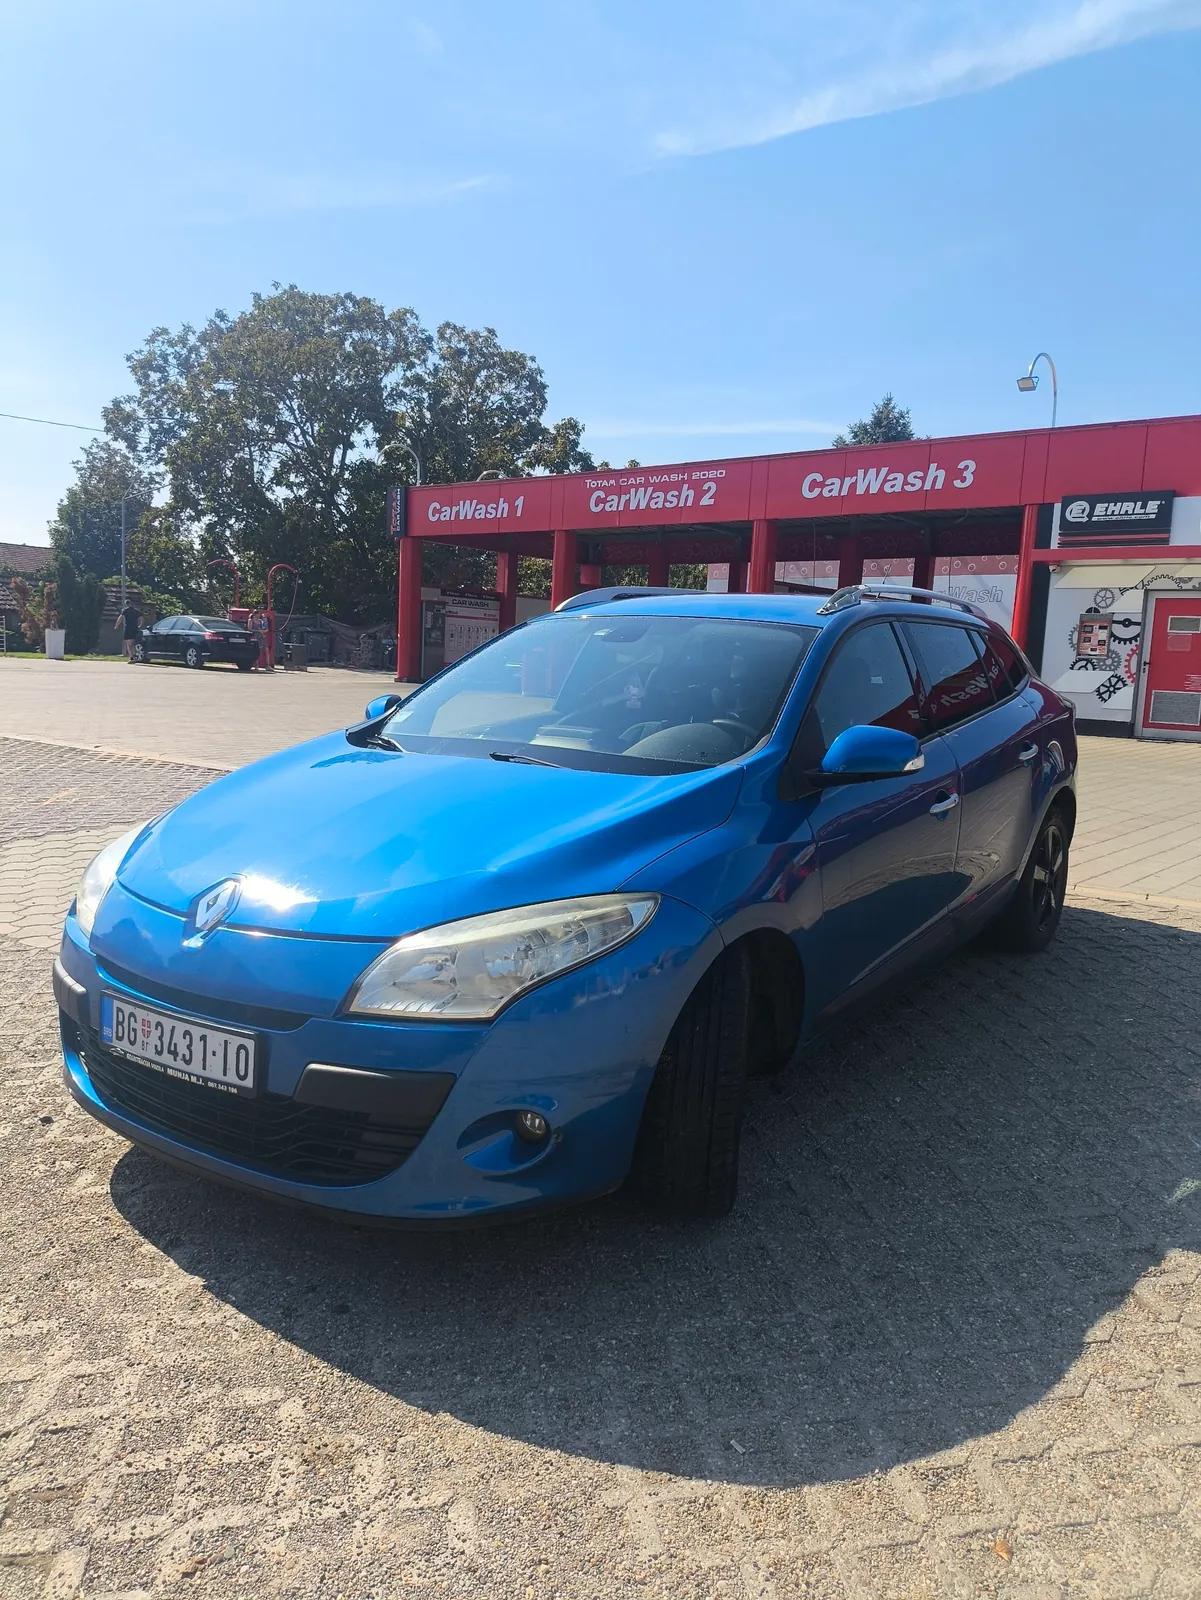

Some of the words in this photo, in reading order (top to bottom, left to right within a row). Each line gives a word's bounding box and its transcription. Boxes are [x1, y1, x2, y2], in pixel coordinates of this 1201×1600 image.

[619, 476, 645, 486] CAR
[648, 473, 688, 484] WASH
[691, 469, 726, 480] 2020
[801, 463, 946, 499] CarWash
[953, 459, 977, 489] 3
[589, 483, 695, 513] CarWash
[700, 481, 717, 506] 2
[1093, 500, 1161, 516] EHRLE
[428, 497, 509, 522] CarWash
[514, 495, 525, 517] 1
[452, 598, 467, 606] CAR
[468, 600, 490, 608] WASH
[116, 1006, 138, 1047] BG
[166, 1067, 190, 1082] MUNJA
